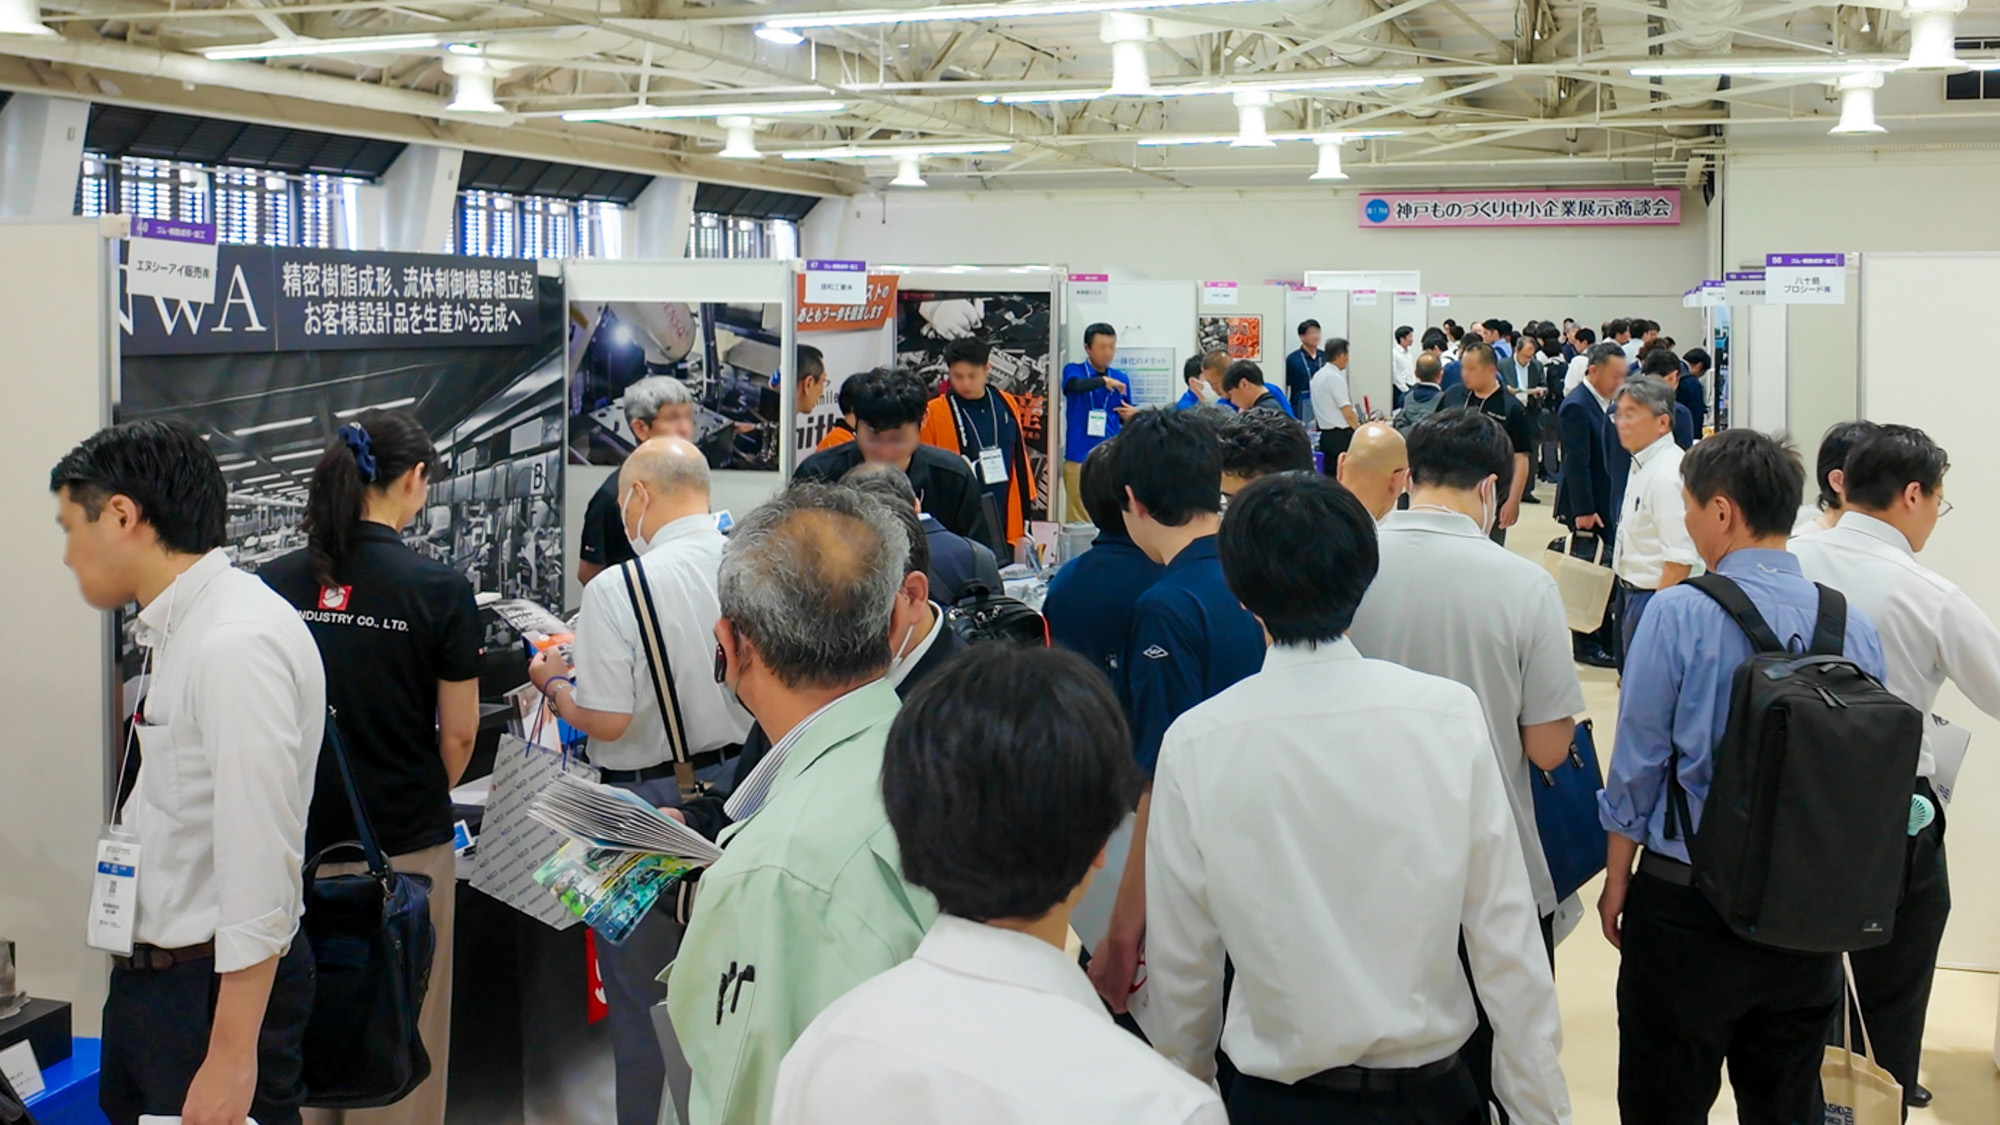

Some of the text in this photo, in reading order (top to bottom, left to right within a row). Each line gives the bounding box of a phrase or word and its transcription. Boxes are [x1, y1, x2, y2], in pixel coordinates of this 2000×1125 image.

[1397, 199, 1671, 218] 神戸ものづくり中小企業展示商談会
[282, 261, 534, 300] 精密樹脂成形、流体制御機器組立迄
[304, 301, 522, 336] お客様設計品を生産から完成へ
[533, 463, 543, 490] B
[298, 610, 354, 625] NDUSTRY
[383, 621, 410, 632] LTD.
